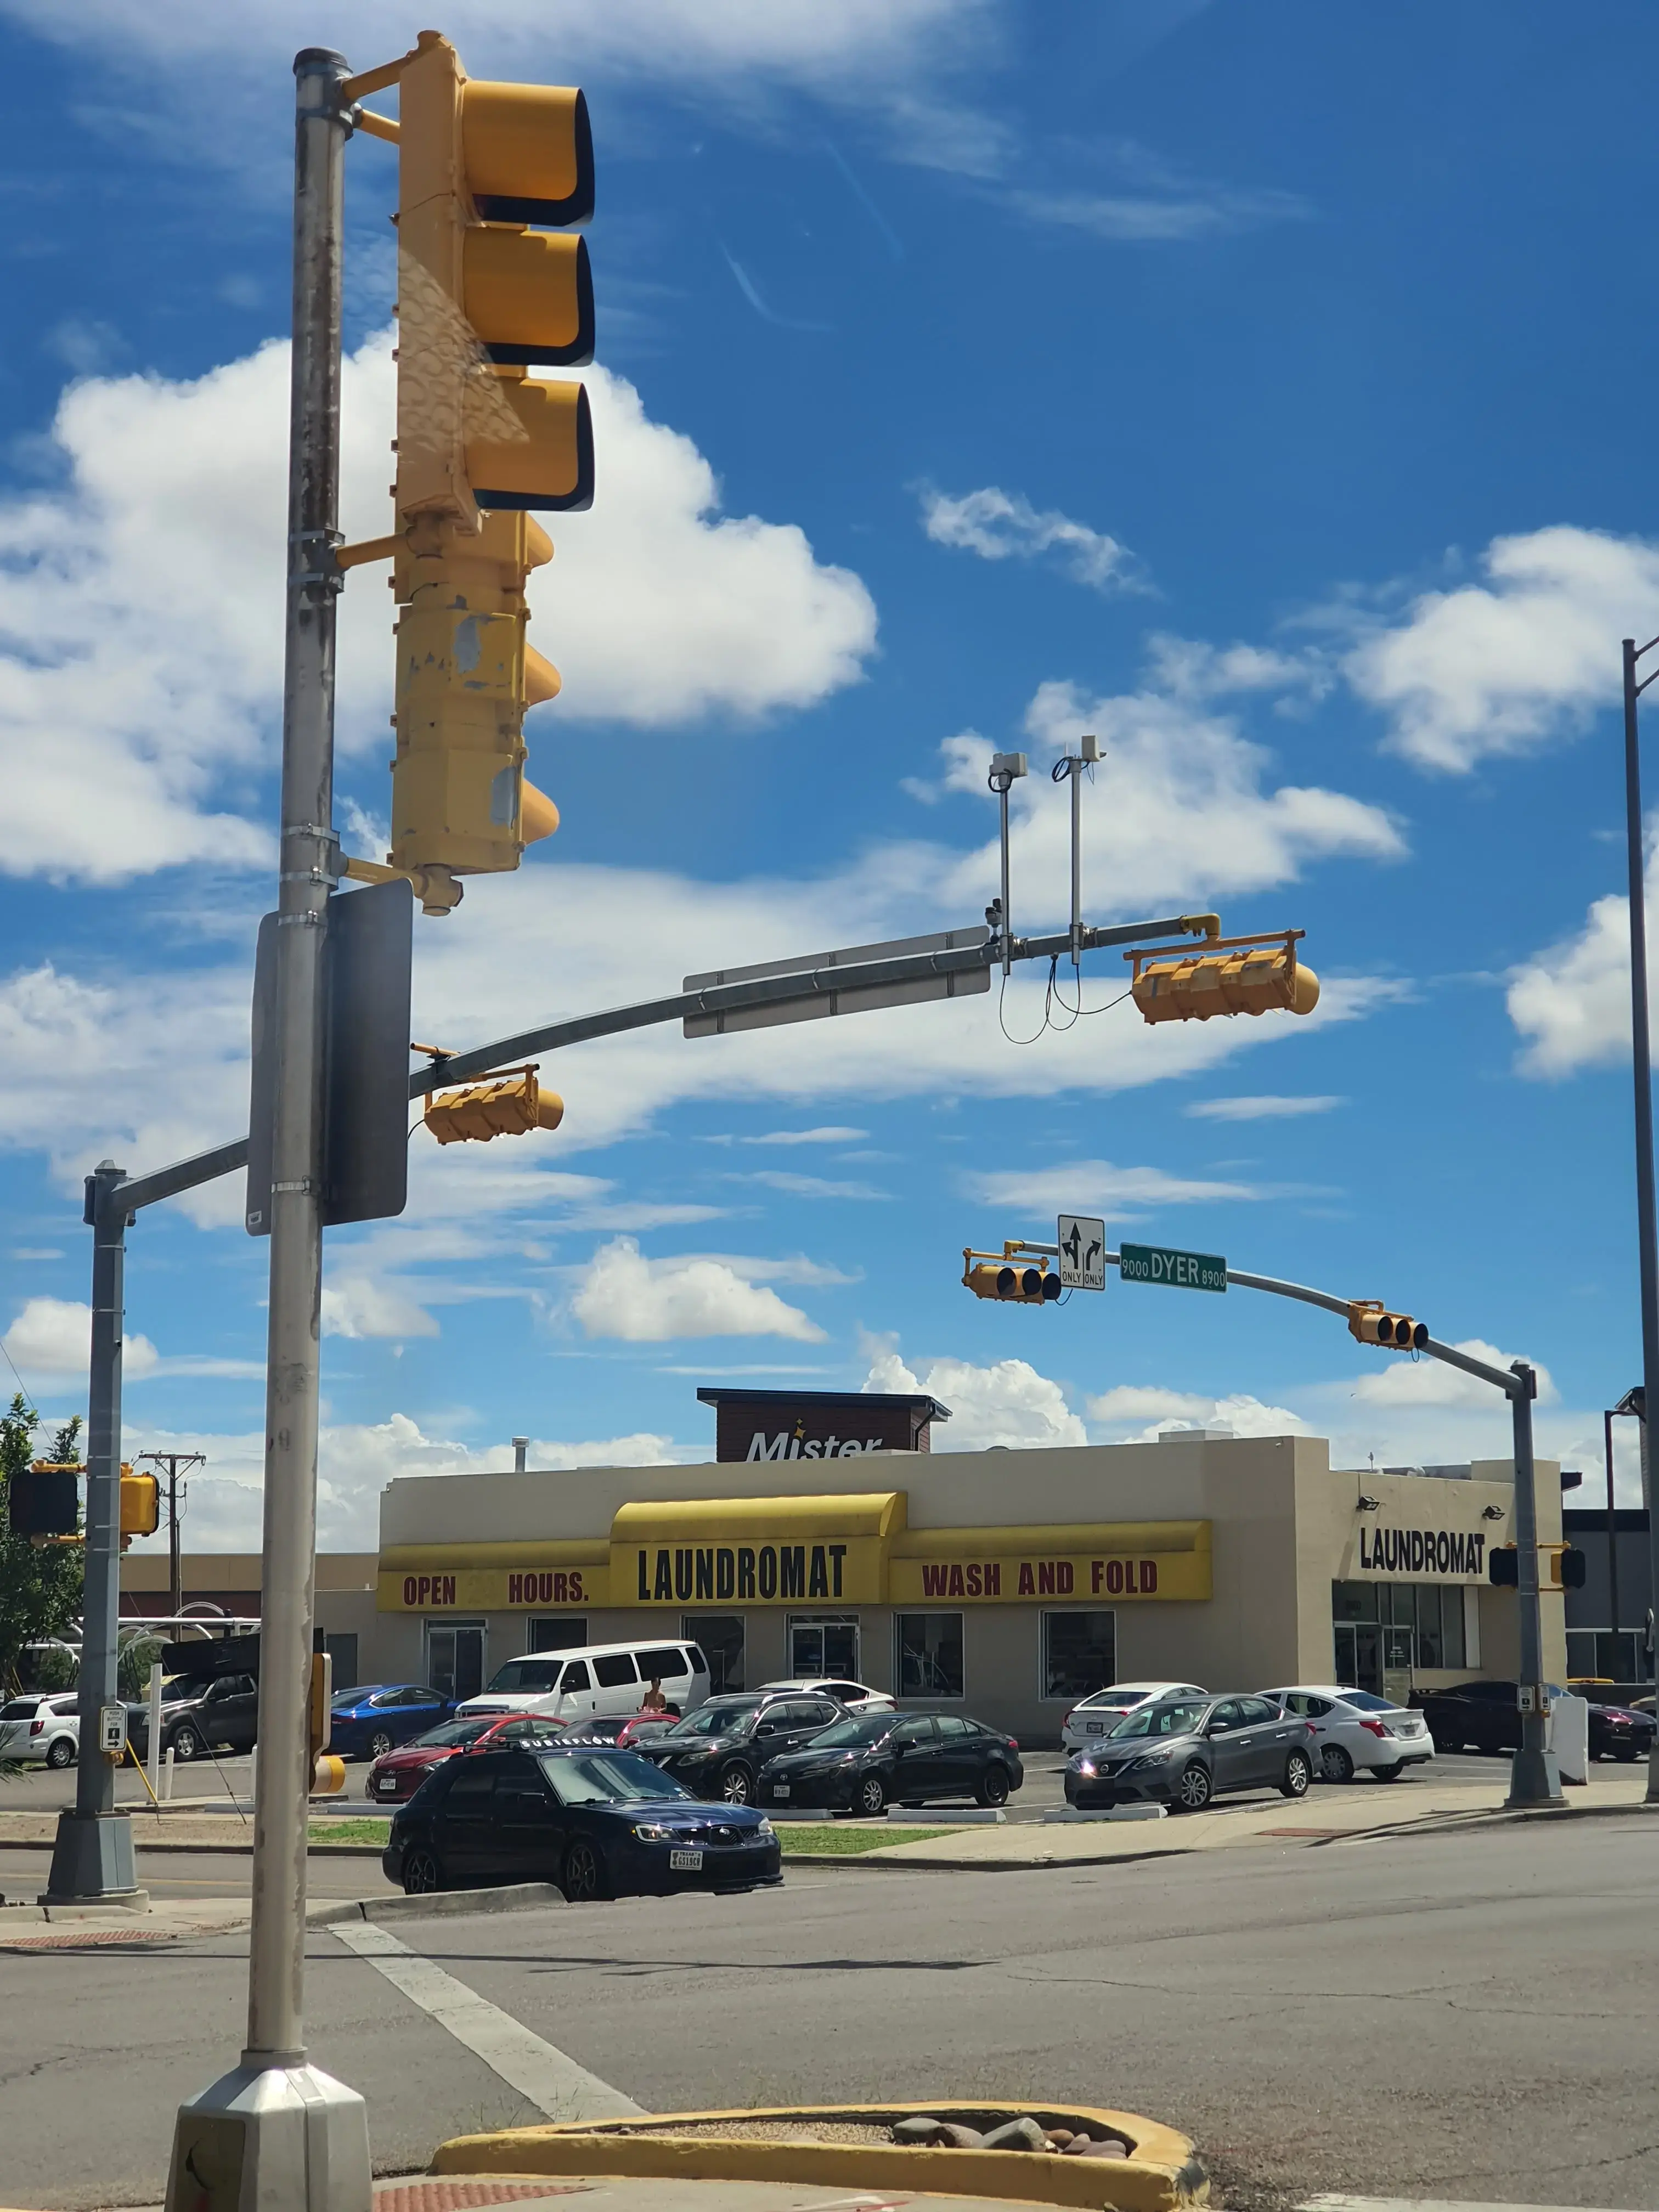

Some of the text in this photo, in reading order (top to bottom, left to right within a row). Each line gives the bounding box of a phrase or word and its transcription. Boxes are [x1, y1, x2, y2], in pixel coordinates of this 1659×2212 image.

[1062, 1271, 1081, 1283] ONLY
[1085, 1273, 1103, 1285] ONLY
[1122, 1252, 1225, 1288] 9000 DYER 8900
[1361, 1527, 1485, 1574] LAUNDROMAT
[403, 1571, 589, 1606] OPEN HOURS.
[638, 1544, 847, 1601] LAUNDROMAT
[922, 1560, 1158, 1597] WASH AND FOLD
